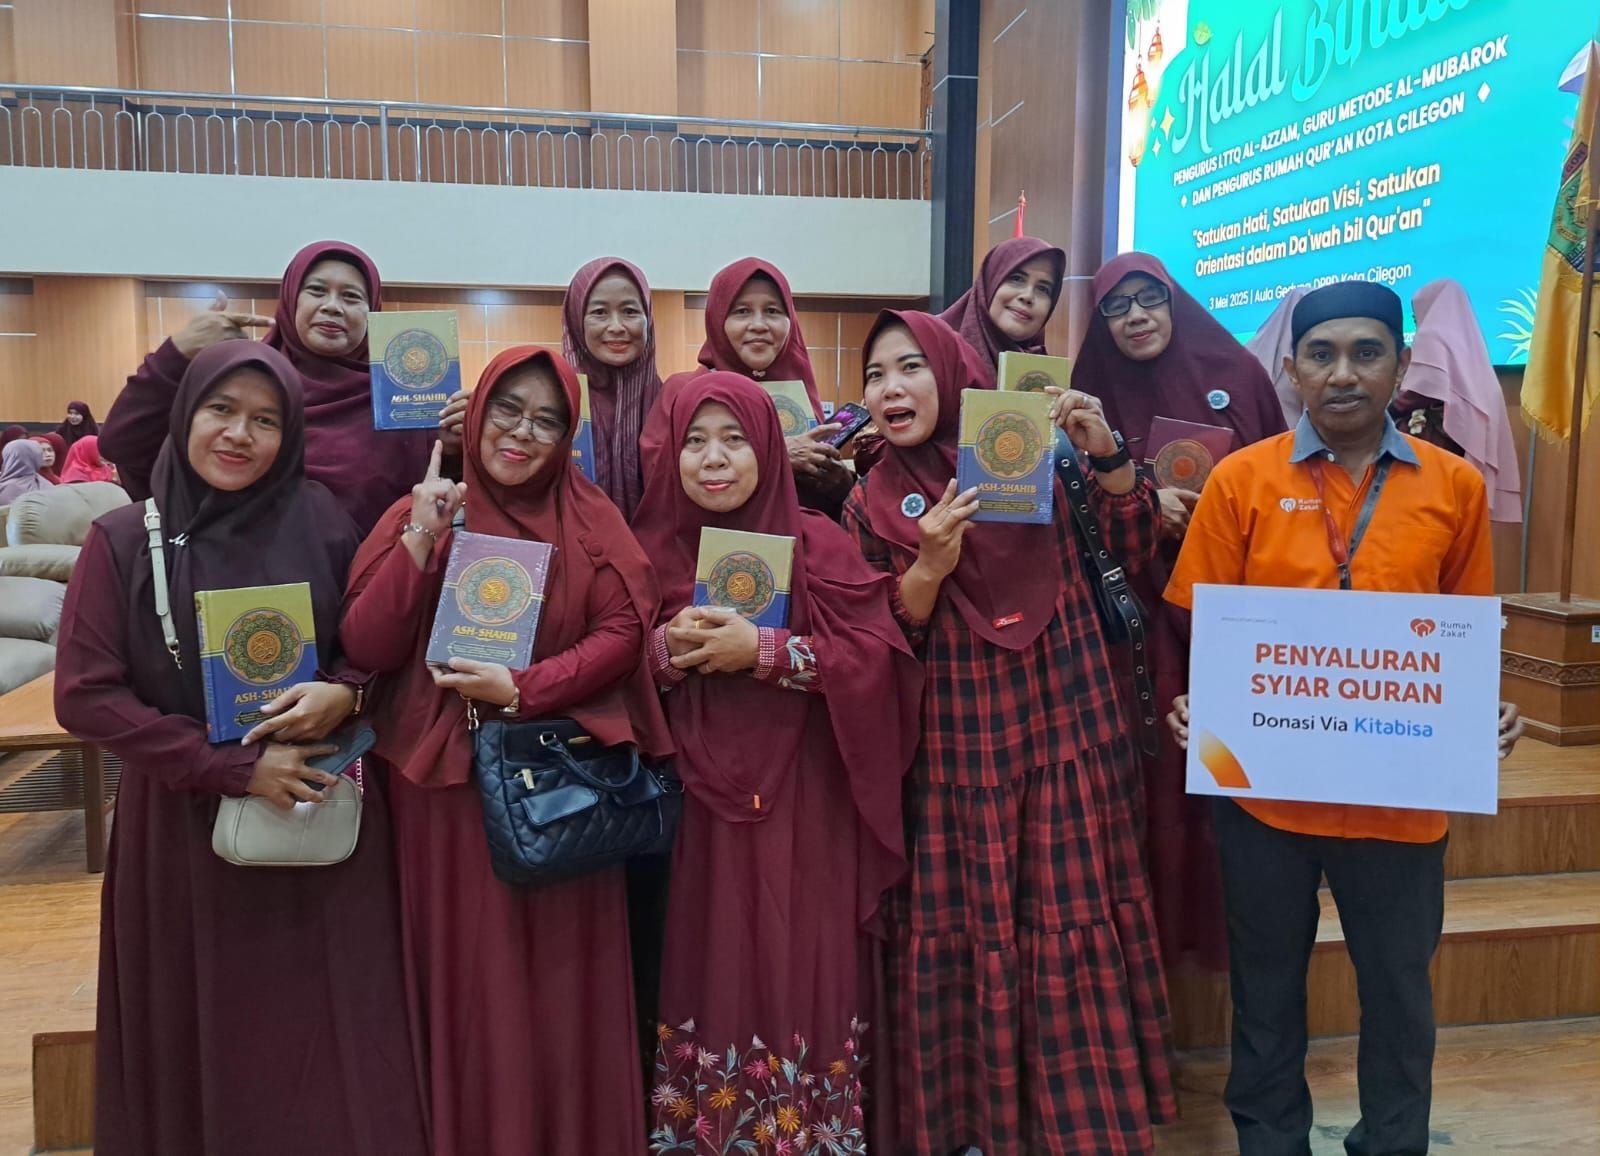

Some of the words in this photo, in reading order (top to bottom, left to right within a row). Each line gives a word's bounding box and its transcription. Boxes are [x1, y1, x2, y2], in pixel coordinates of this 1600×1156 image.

[1171, 5, 1288, 154] Halal
[1173, 155, 1217, 186] PENGURUS
[1242, 122, 1300, 160] AL-AZZAM,
[1303, 107, 1336, 135] GURU
[1338, 83, 1393, 122] METODE
[1395, 34, 1509, 100] AL-MUBAROK
[1192, 185, 1212, 206] DAN
[1212, 167, 1263, 198] PENGURUS
[1264, 152, 1304, 181] RUMAH
[1355, 119, 1394, 149] KOTA
[1396, 92, 1465, 134] CILEGON
[1242, 208, 1271, 236] Hati,
[1272, 196, 1329, 227] Satukan
[1332, 180, 1364, 210] Visi,
[1367, 162, 1440, 201] Satukan
[1195, 246, 1245, 277] Orientasi
[1246, 241, 1287, 266] dalam
[1289, 225, 1341, 256] Da'wah
[1343, 217, 1363, 243] bil
[1209, 297, 1214, 311] 3
[1215, 294, 1229, 309] Mei
[1229, 290, 1249, 307] 2025
[1254, 287, 1274, 302] Aula
[1367, 263, 1412, 286] Cilegon
[979, 483, 1037, 494] ASH-SHAHIB
[453, 625, 518, 641] ASH-SHAHIB
[1440, 620, 1472, 630] Rumah
[1440, 630, 1466, 638] Zakat
[1255, 643, 1441, 673] PENYALURAN
[235, 687, 289, 704] ASH-SHA
[1251, 673, 1330, 698] SYIAR
[1338, 678, 1442, 705] QURAN
[1252, 712, 1315, 730] Donasi
[1320, 715, 1348, 732] Via
[1354, 717, 1433, 738] Kitabisa
